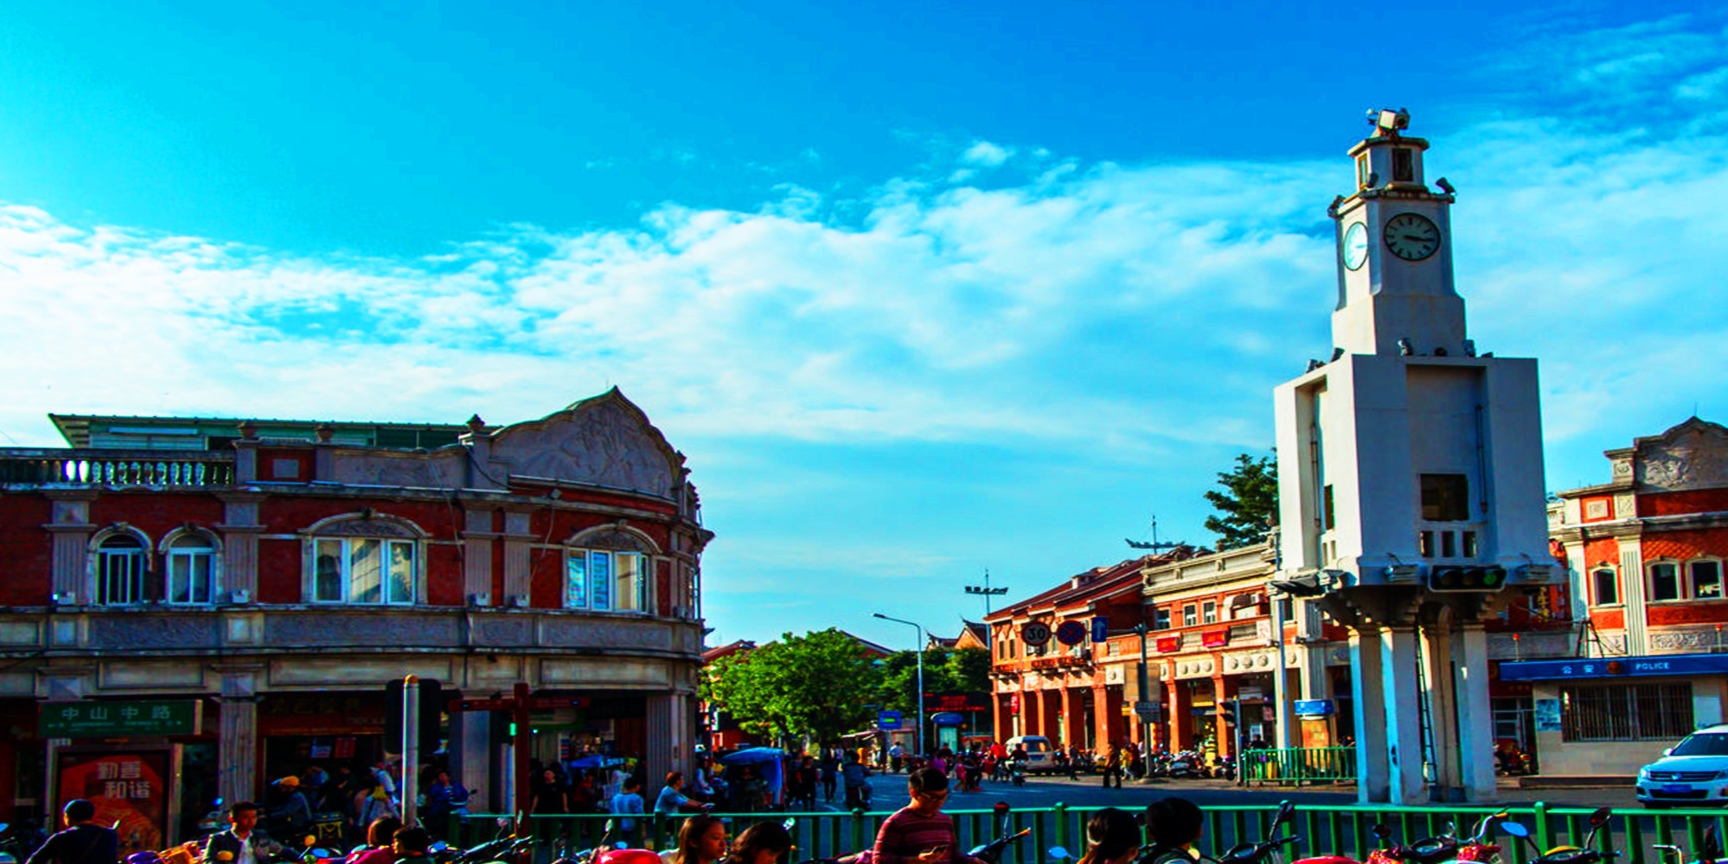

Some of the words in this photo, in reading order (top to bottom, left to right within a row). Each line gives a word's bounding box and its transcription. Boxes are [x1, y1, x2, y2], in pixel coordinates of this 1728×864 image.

[1027, 627, 1046, 640] 30
[1562, 664, 1594, 674] 公安
[1636, 662, 1669, 670] POLICE
[62, 705, 170, 720] 中山中路
[104, 781, 150, 799] 和谐
